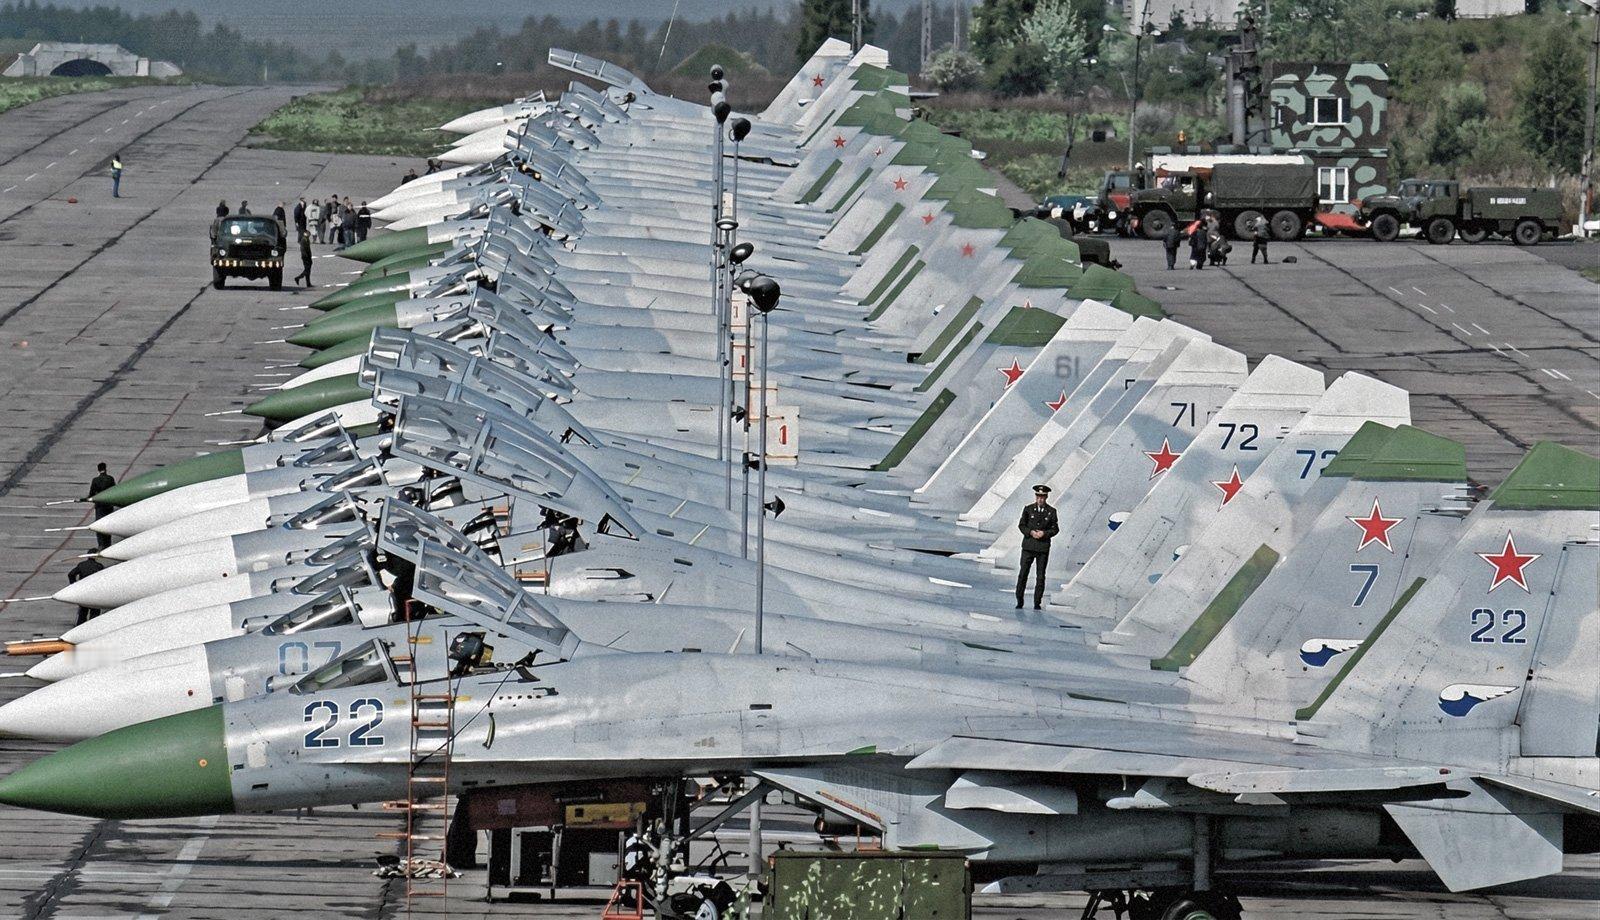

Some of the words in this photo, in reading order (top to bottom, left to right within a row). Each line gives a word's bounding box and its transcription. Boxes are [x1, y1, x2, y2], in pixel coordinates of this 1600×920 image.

[1055, 355, 1080, 379] 61
[1170, 402, 1195, 427] 71
[1218, 423, 1259, 450] 72
[1350, 563, 1380, 608] 7
[1469, 607, 1528, 644] 22
[278, 640, 342, 674] 07
[303, 697, 386, 749] 22
